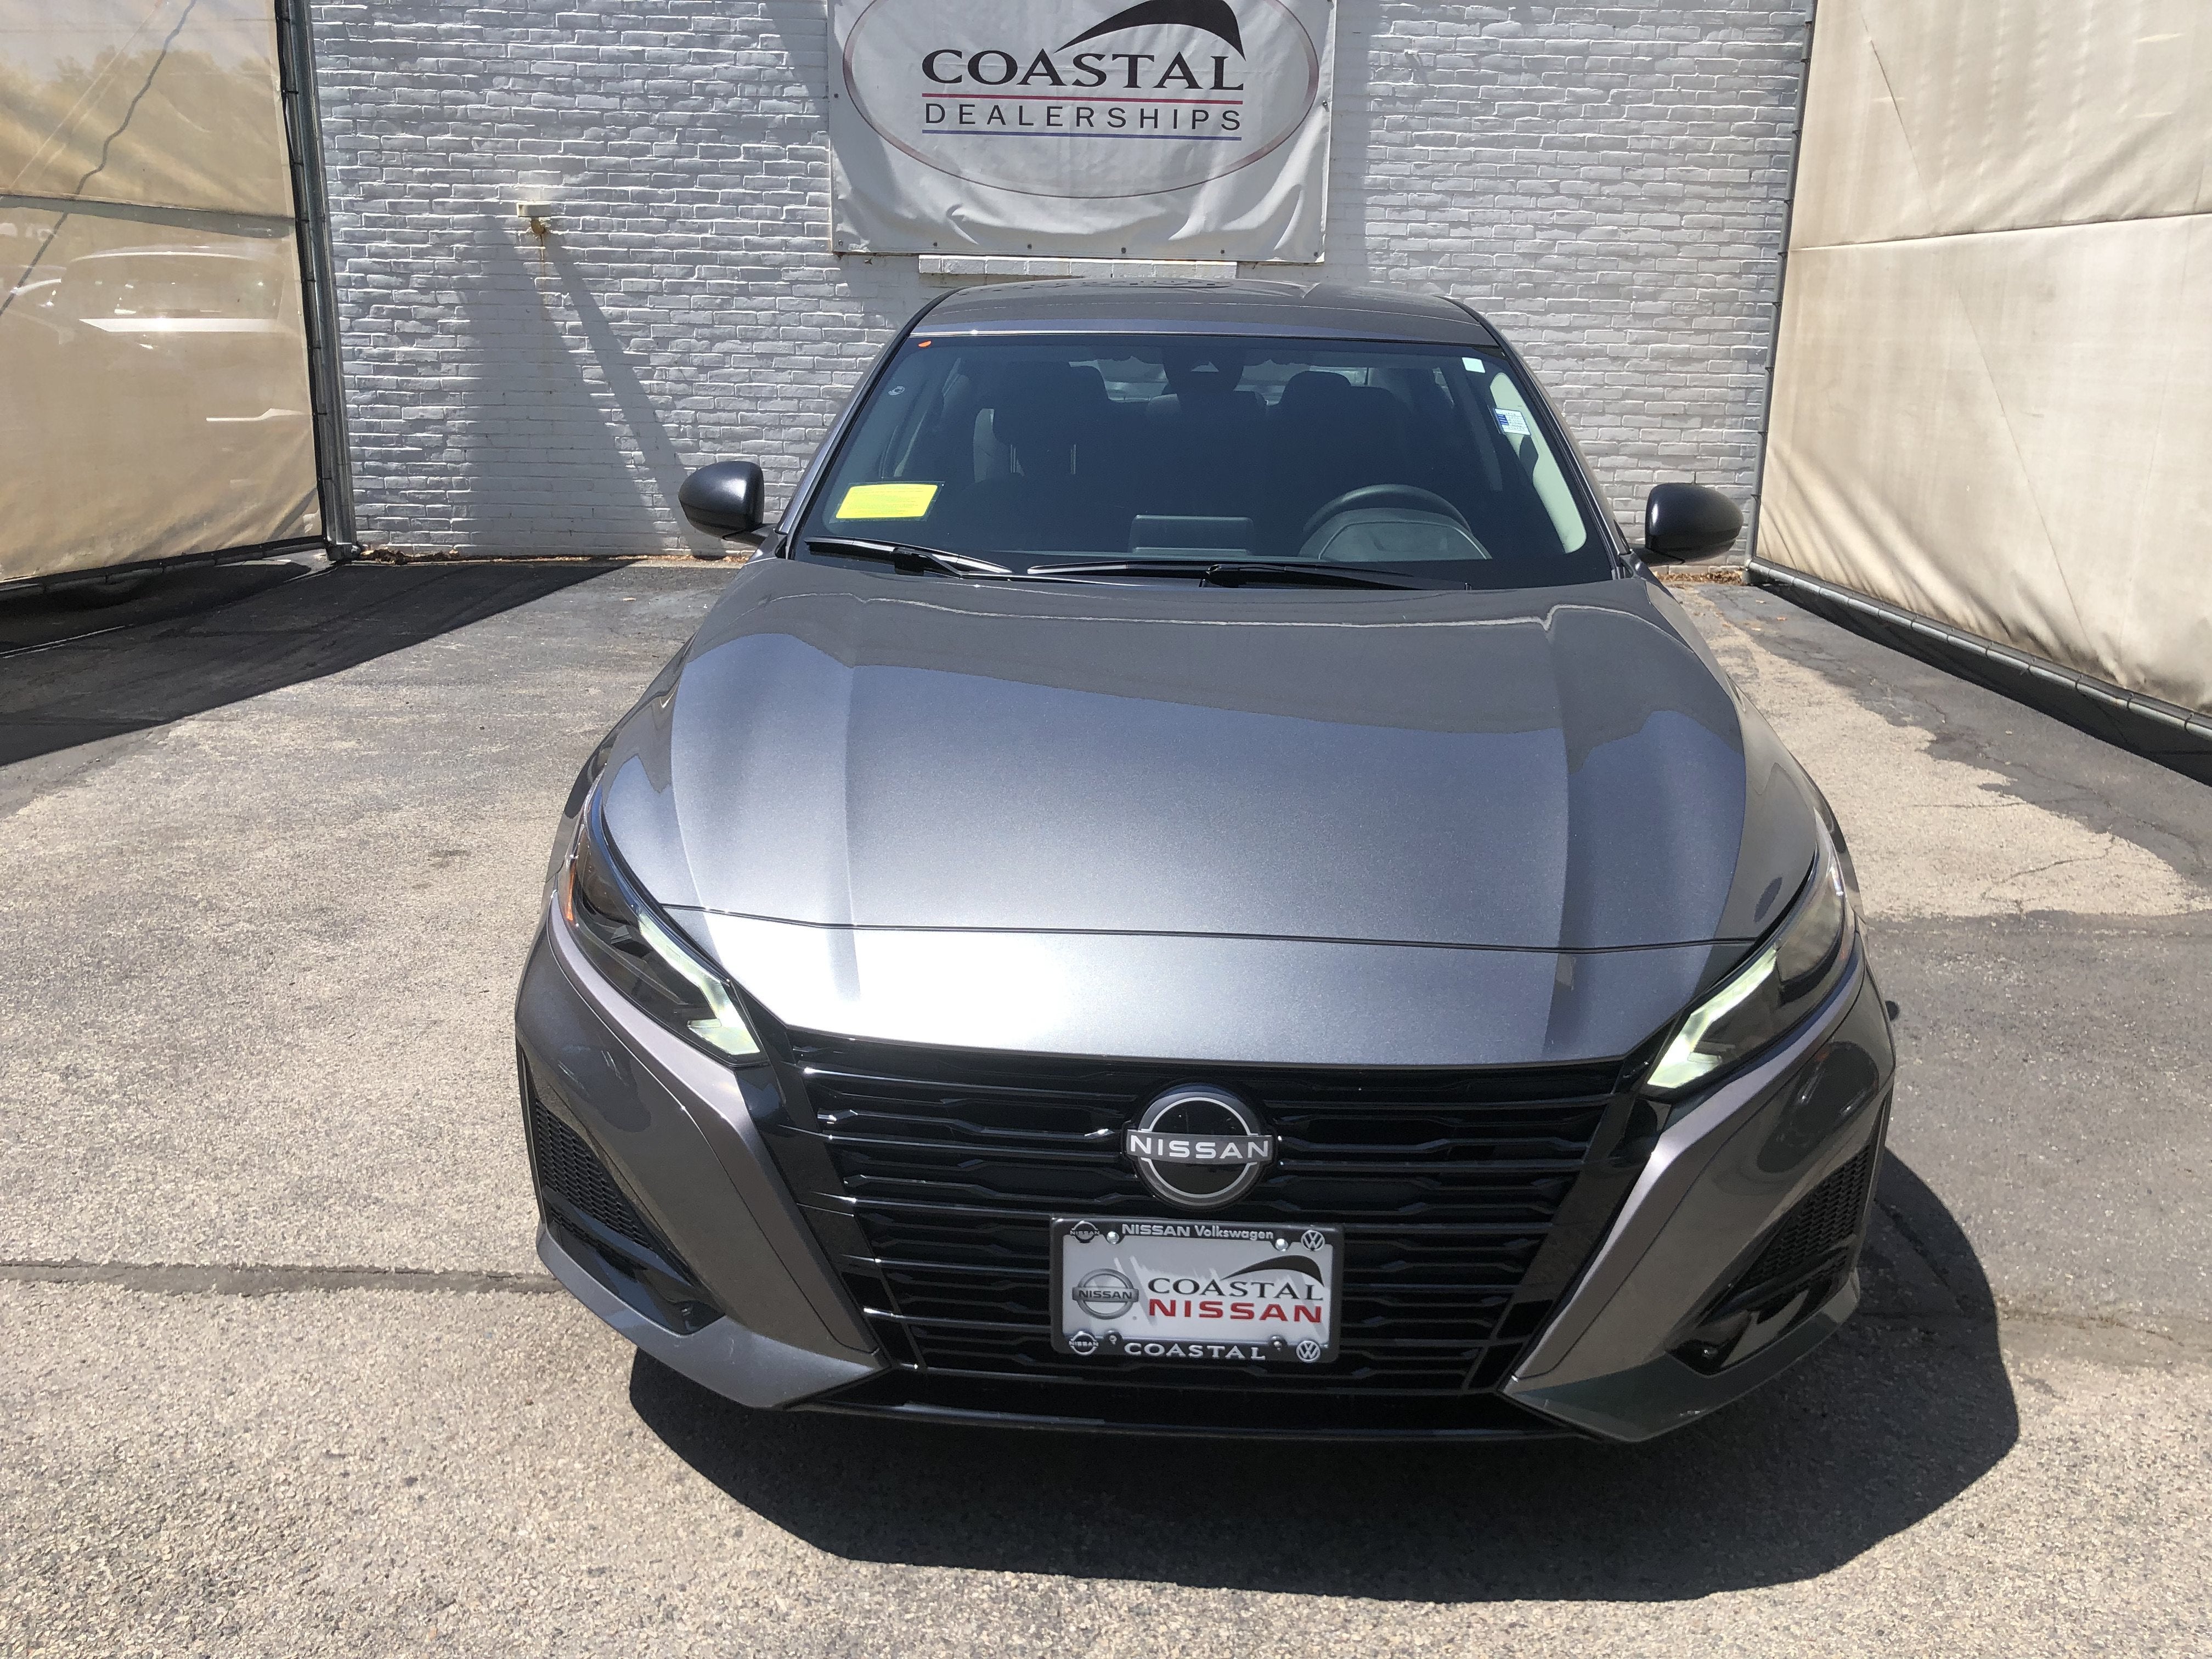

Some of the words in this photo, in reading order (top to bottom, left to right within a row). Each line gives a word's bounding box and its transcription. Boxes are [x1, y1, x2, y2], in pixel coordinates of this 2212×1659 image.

[922, 48, 1244, 91] COASTAL
[926, 103, 1242, 131] DEALERSHIPS
[1130, 1135, 1268, 1159] NISSAN
[1122, 1223, 1190, 1237] NISSAN
[1195, 1225, 1274, 1240] Volkswagen
[1079, 1289, 1132, 1300] NISSAN
[1148, 1277, 1324, 1301] COASTAL
[1149, 1299, 1322, 1323] NISSAN
[1124, 1342, 1266, 1361] COASTAL
